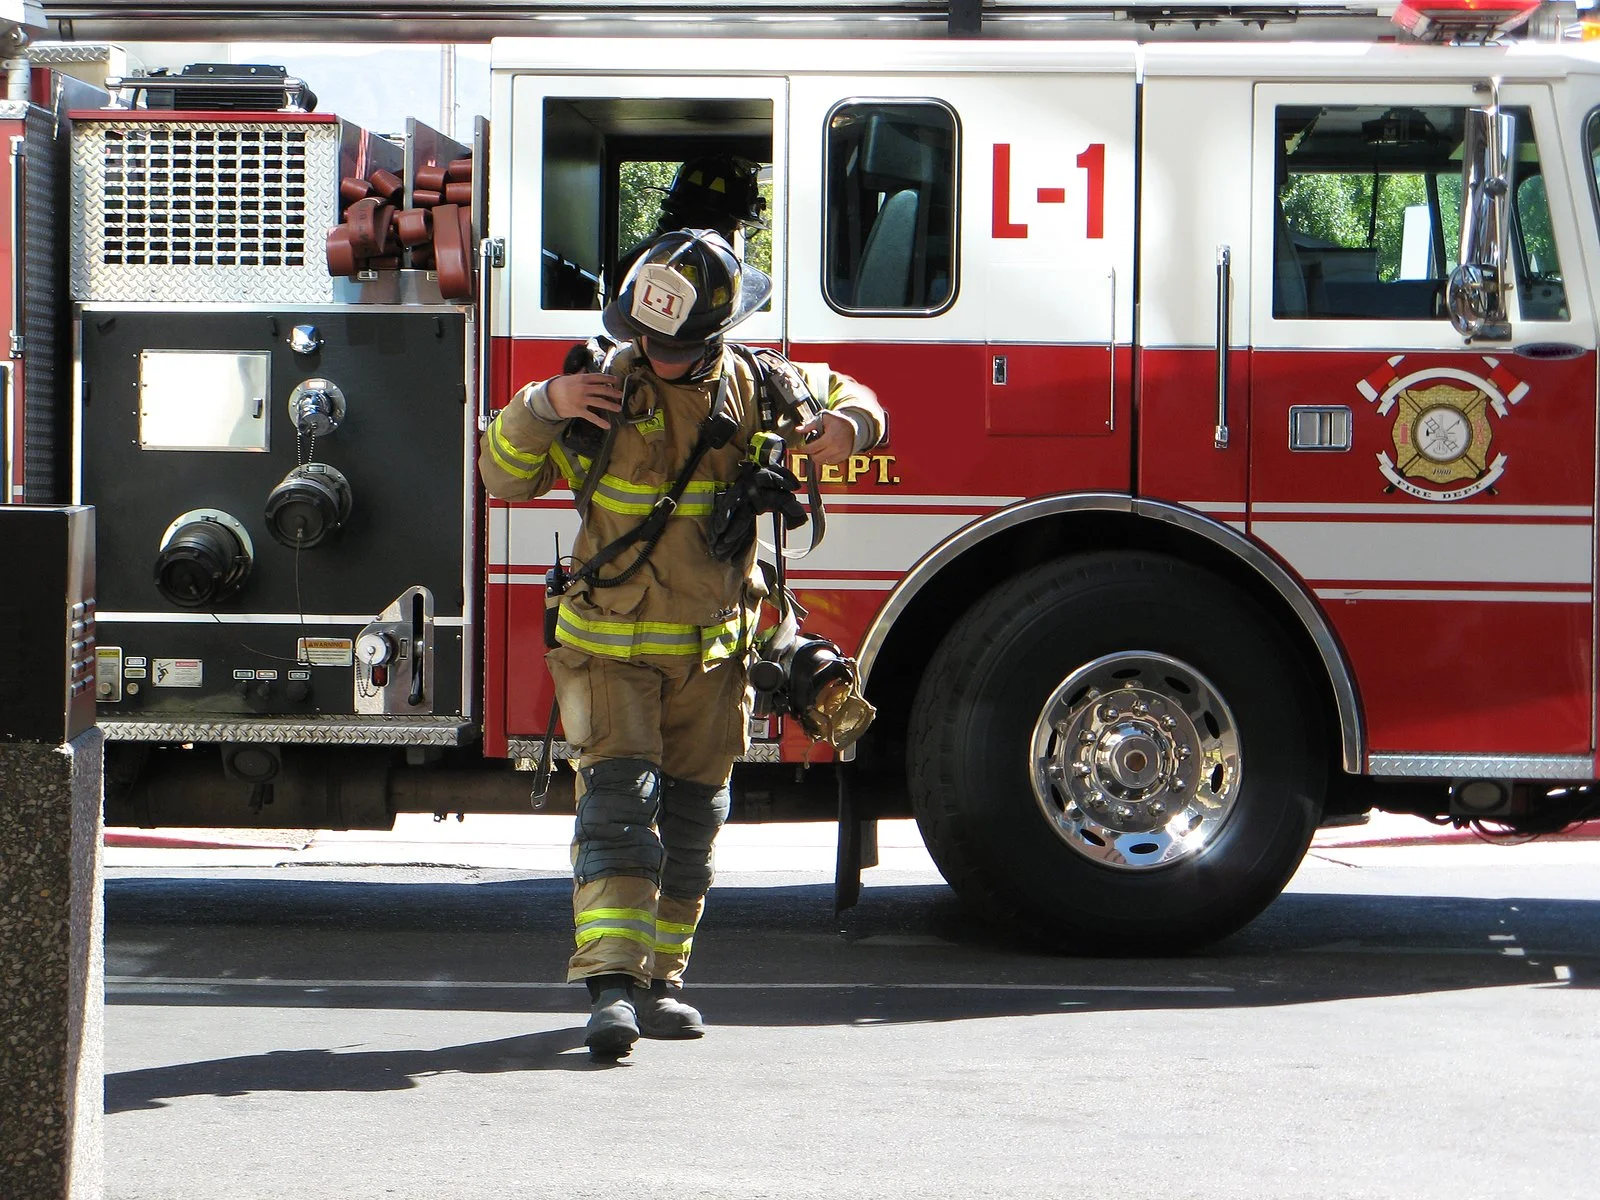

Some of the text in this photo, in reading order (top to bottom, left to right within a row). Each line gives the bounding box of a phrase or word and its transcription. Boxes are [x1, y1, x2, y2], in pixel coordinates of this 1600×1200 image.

[991, 143, 1105, 239] L-1
[642, 284, 675, 316] L-1
[1396, 479, 1483, 500] FIRE DEPT
